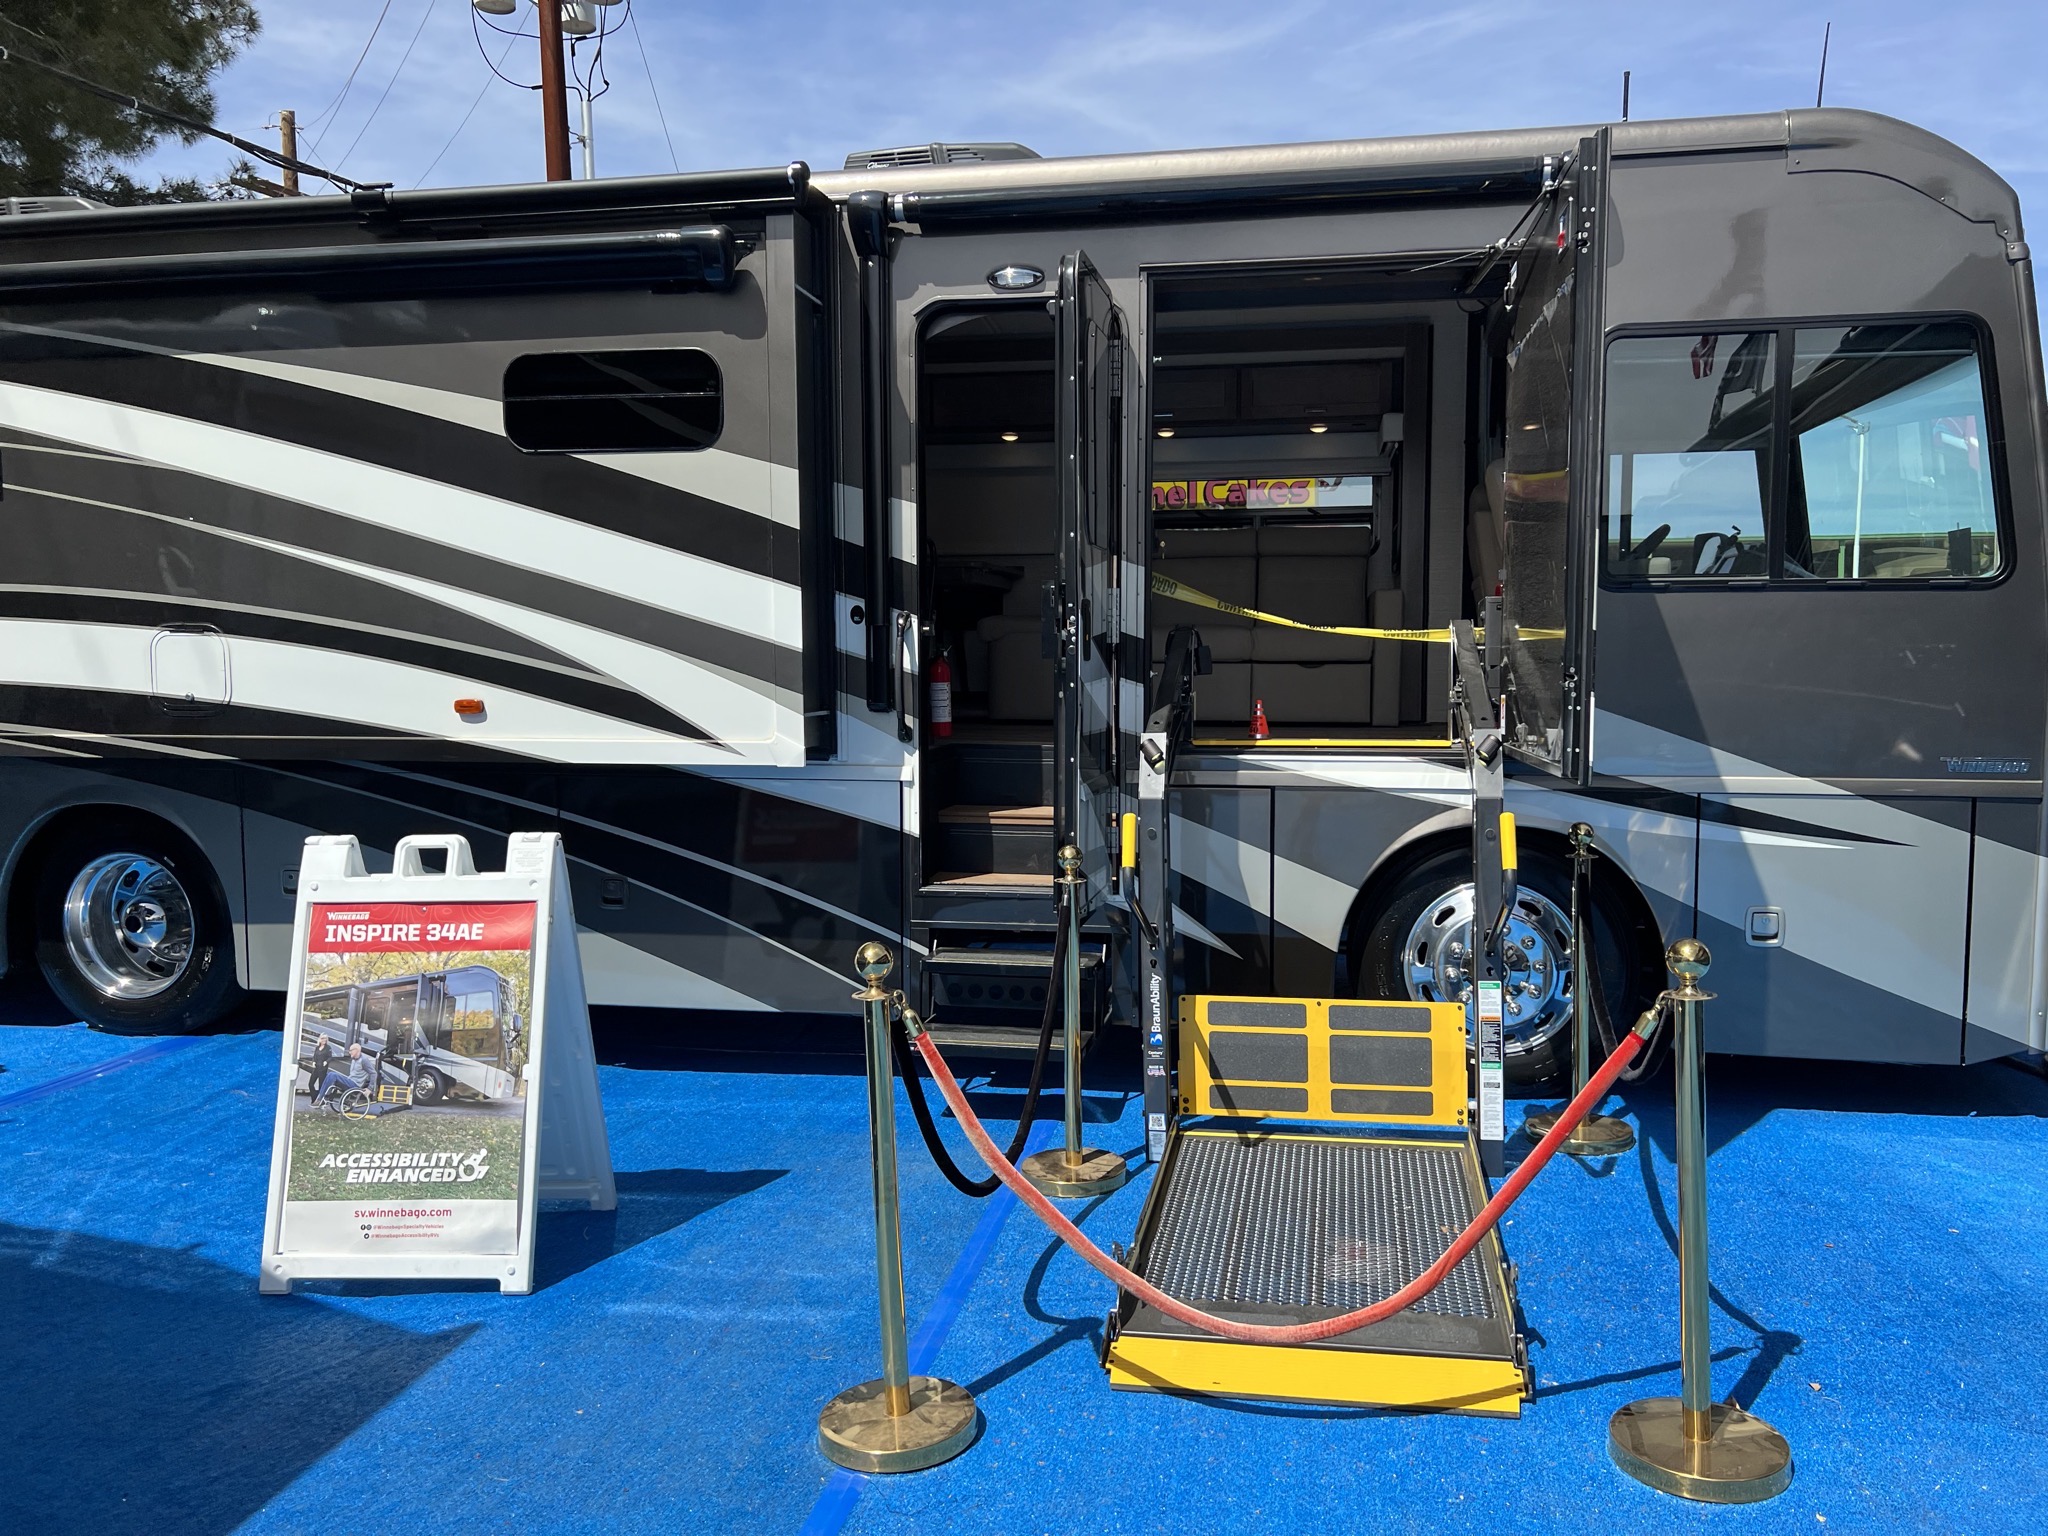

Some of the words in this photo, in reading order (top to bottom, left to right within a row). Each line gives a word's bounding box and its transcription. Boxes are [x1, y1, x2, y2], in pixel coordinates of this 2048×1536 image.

[1203, 478, 1311, 507] Cakes
[1940, 757, 2031, 773] WINNEBAGO
[327, 911, 370, 921] WINNEBAGO
[325, 924, 420, 942] INSPIRE
[426, 923, 485, 941] 34AE
[1150, 972, 1162, 1033] BraunAbility
[319, 1152, 465, 1168] ACCESSIBILITY
[345, 1168, 458, 1183] ENHANCED
[354, 1207, 452, 1219] sv.winnebago.com
